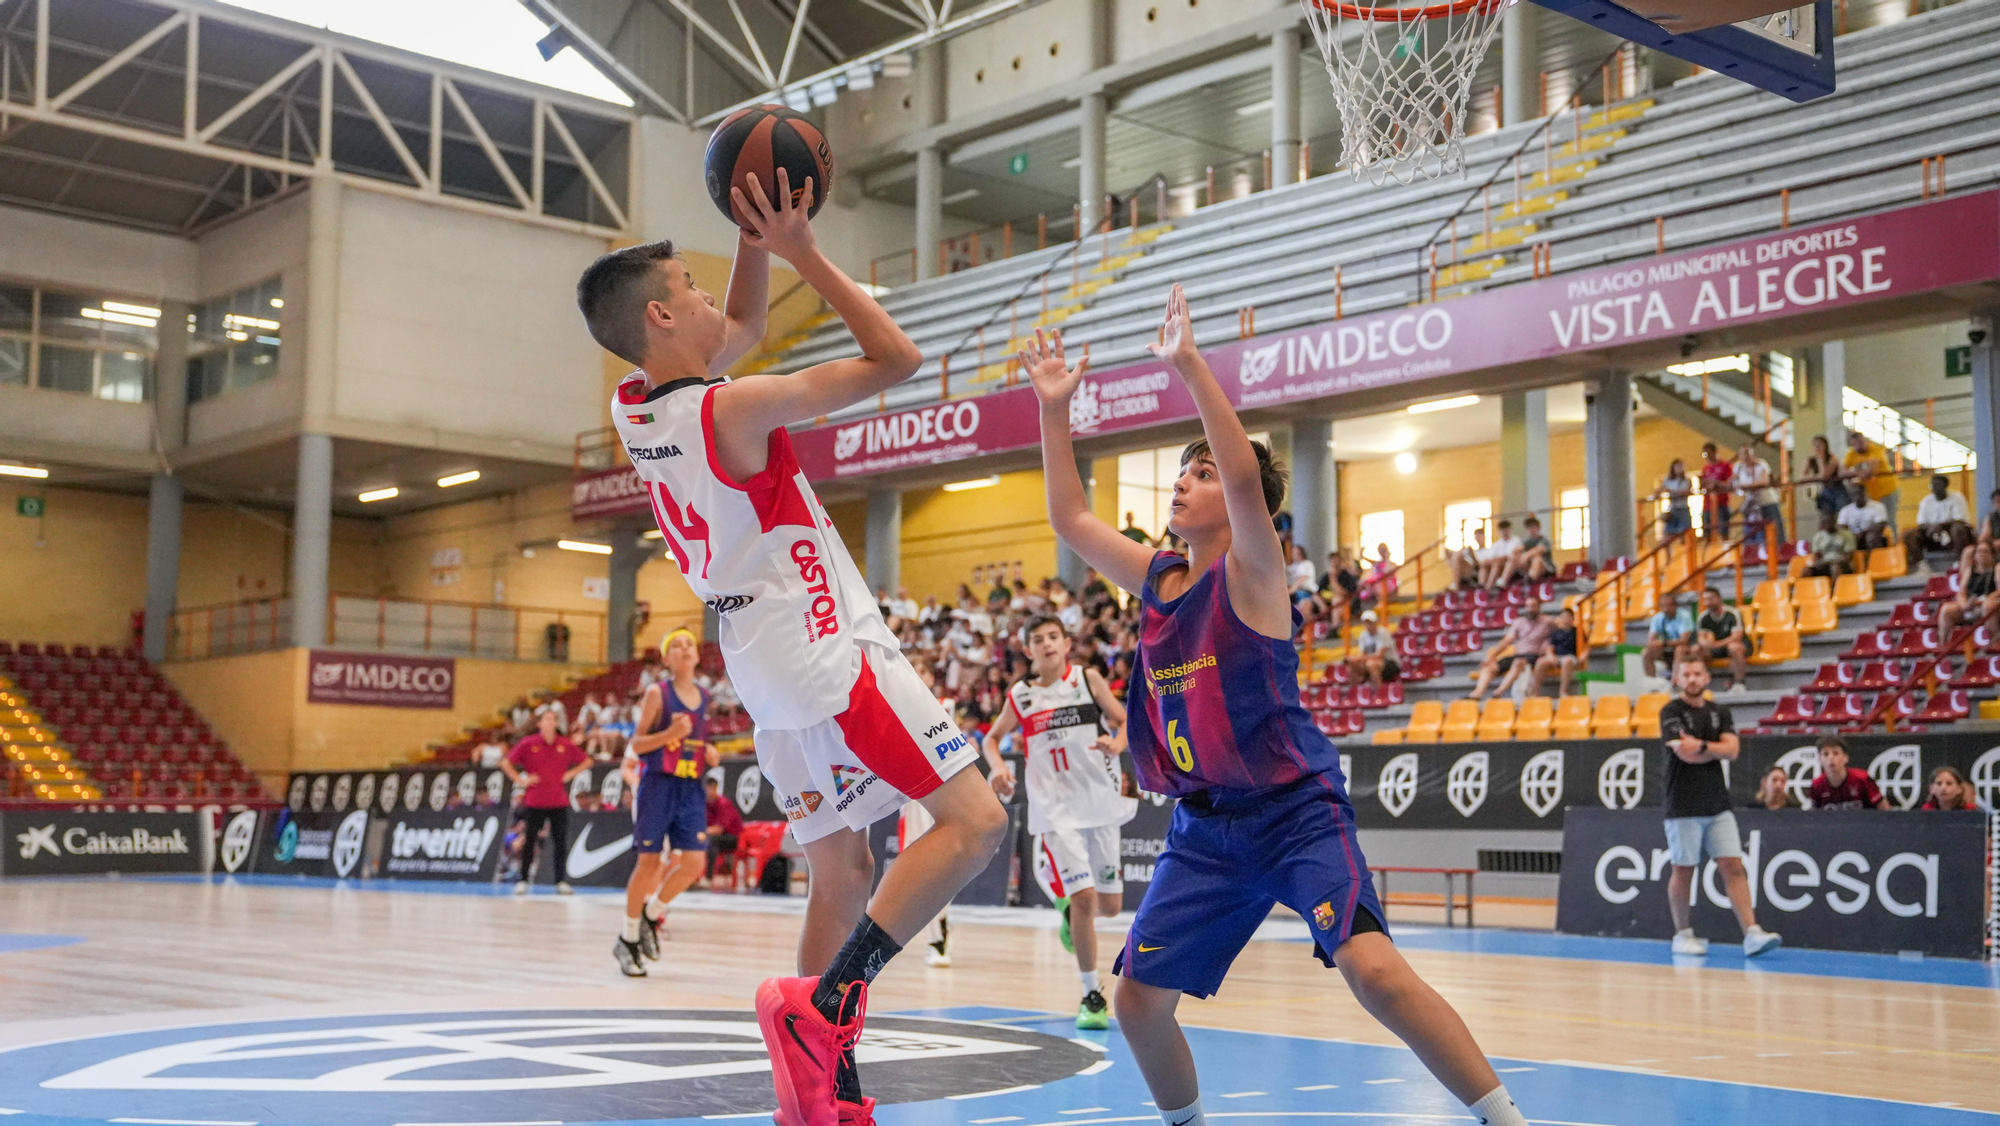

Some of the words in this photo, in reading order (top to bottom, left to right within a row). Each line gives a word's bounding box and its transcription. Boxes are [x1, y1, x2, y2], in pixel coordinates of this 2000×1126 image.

[1568, 269, 1645, 299] PALACIO
[1648, 248, 1751, 285] MUNICIPAL
[1756, 225, 1859, 264] DEPORTES
[1549, 290, 1675, 349] VISTA
[1688, 246, 1893, 325] ALEGRE
[1286, 308, 1453, 377] IMDECO
[866, 401, 980, 454] IMDECO
[589, 471, 648, 500] IMDEC
[790, 539, 839, 640] CASTOR
[804, 611, 816, 644] limpieza
[345, 662, 451, 692] IMDECO
[1157, 676, 1197, 697] anitària
[923, 721, 949, 739] vive
[1049, 747, 1069, 773] 11
[1167, 719, 1194, 773] 6
[806, 794, 819, 805] GD
[836, 790, 857, 812] apdi
[63, 827, 189, 855] CaixaBank
[1595, 829, 1940, 918] endesa
